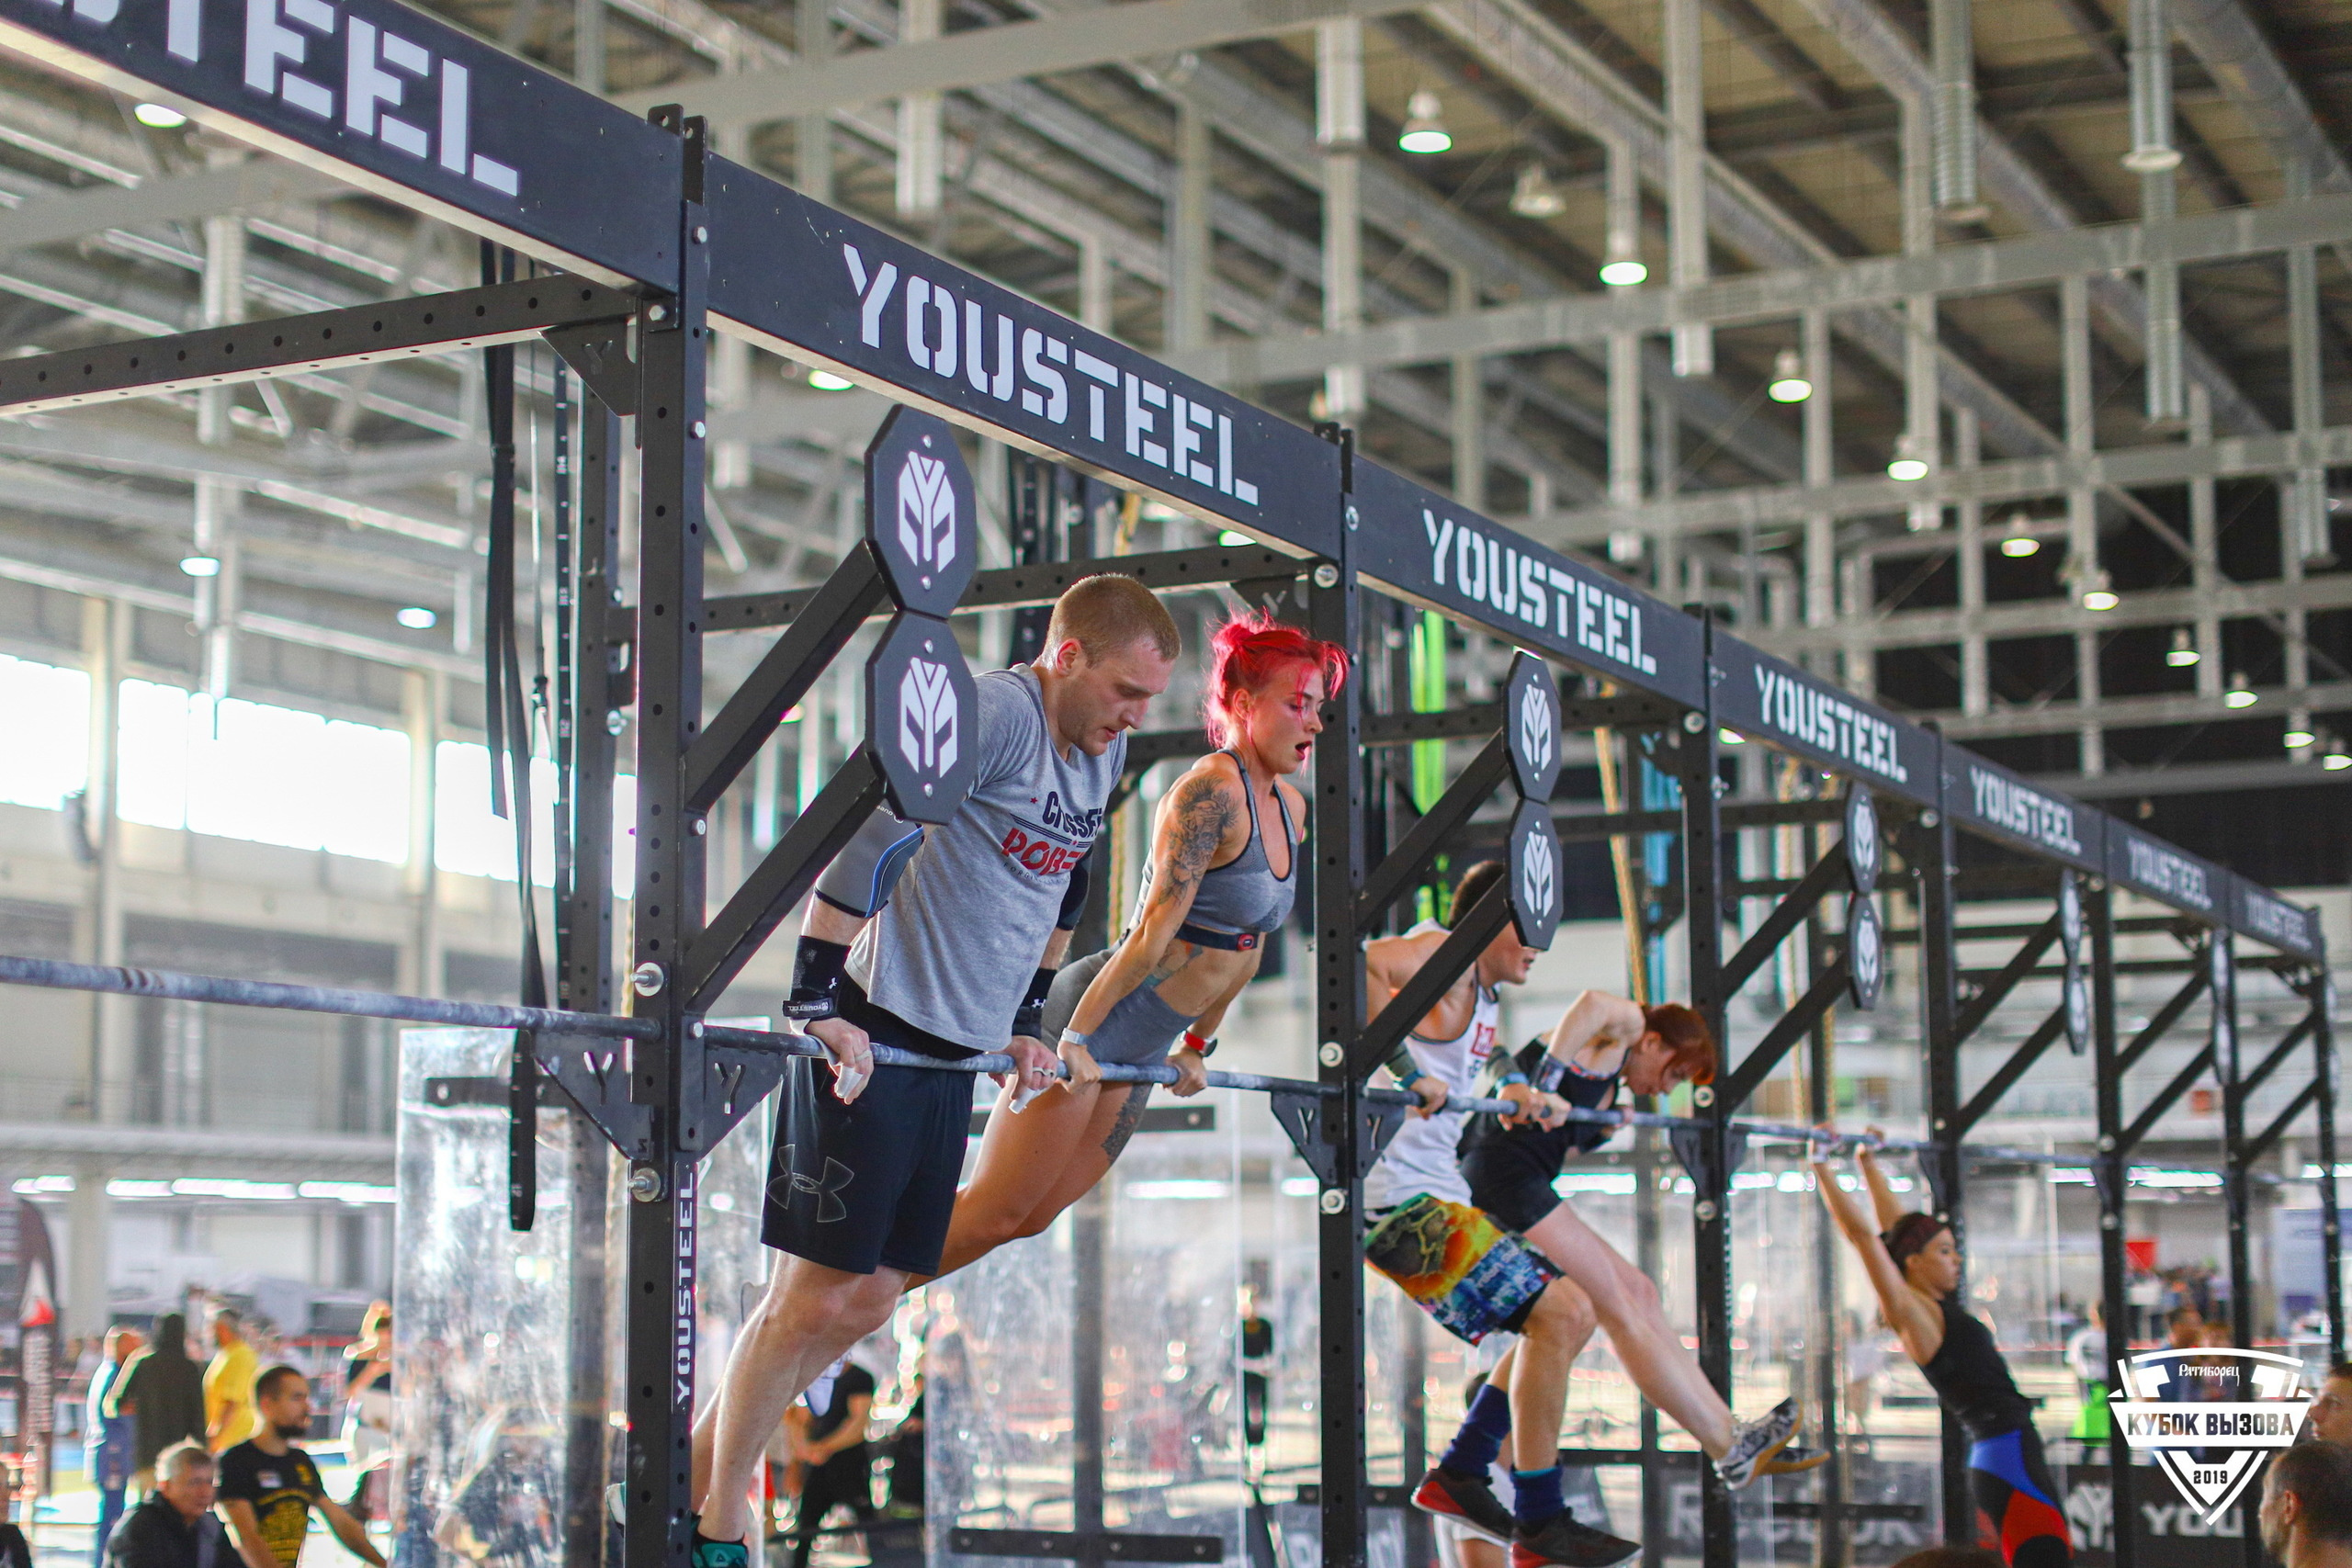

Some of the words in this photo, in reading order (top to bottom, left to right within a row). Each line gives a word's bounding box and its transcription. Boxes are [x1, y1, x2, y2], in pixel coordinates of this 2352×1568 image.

[41, 0, 518, 197] EEL
[843, 243, 1259, 506] YOUSTEEL
[1423, 509, 1657, 675] YOUSTEEL
[1754, 663, 1907, 783] YOUSTEEL
[1970, 765, 2081, 856] YOUSTEEL
[677, 1171, 694, 1405] YOUSTEEL
